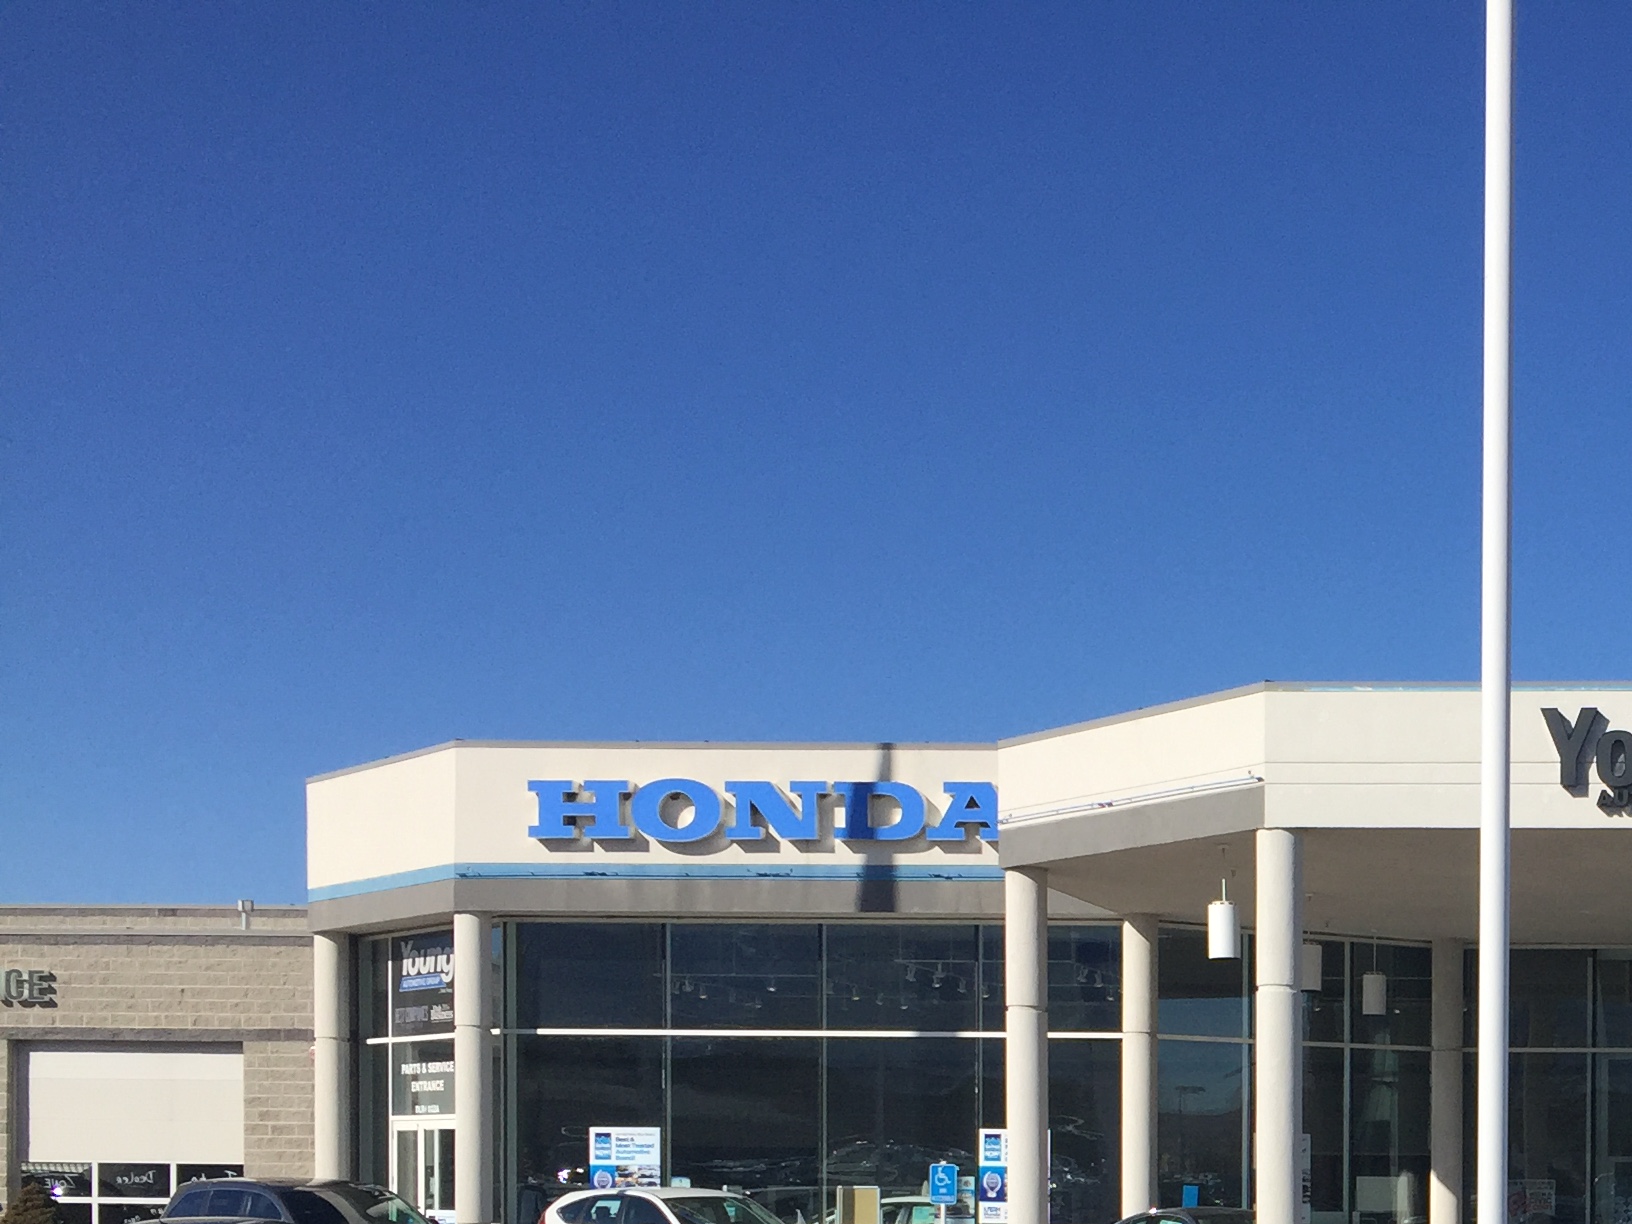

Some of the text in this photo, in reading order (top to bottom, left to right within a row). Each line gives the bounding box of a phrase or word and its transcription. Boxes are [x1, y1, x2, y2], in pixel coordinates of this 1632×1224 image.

[528, 778, 998, 843] HONDA
[400, 940, 455, 983] Young
[401, 1063, 420, 1075] PARTS
[428, 1061, 454, 1073] SERVICE
[411, 1080, 444, 1092] ENTRANCE
